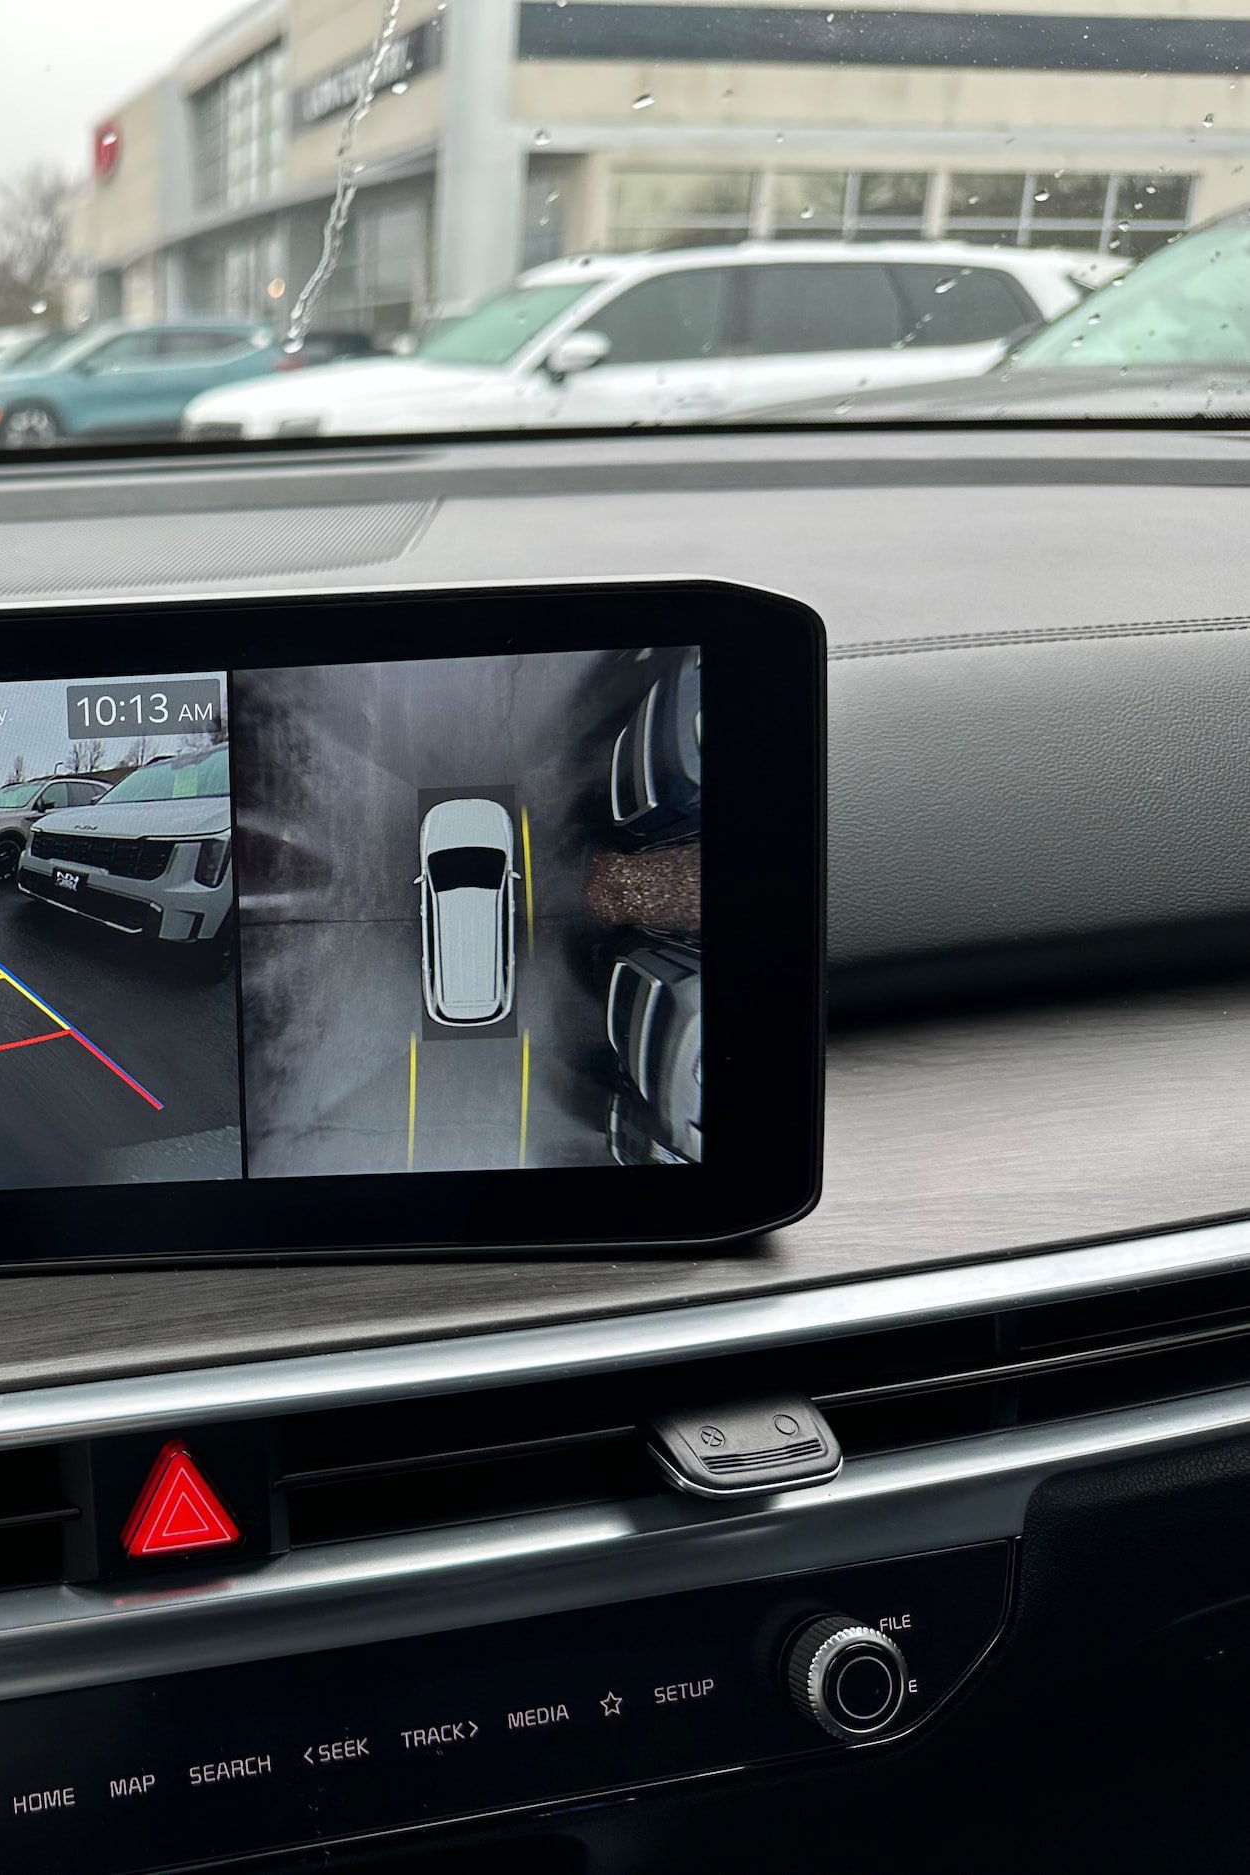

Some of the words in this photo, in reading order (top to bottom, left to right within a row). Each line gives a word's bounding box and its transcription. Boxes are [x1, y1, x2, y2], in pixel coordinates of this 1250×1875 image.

[76, 693, 169, 727] 10:13
[178, 702, 213, 722] AM
[879, 1614, 912, 1632] FILE
[654, 1678, 715, 1704] SETUP
[507, 1703, 570, 1730] MEDIA
[189, 1754, 272, 1786] SEARCH
[109, 1774, 156, 1799] MAP
[13, 1787, 76, 1815] HOME
